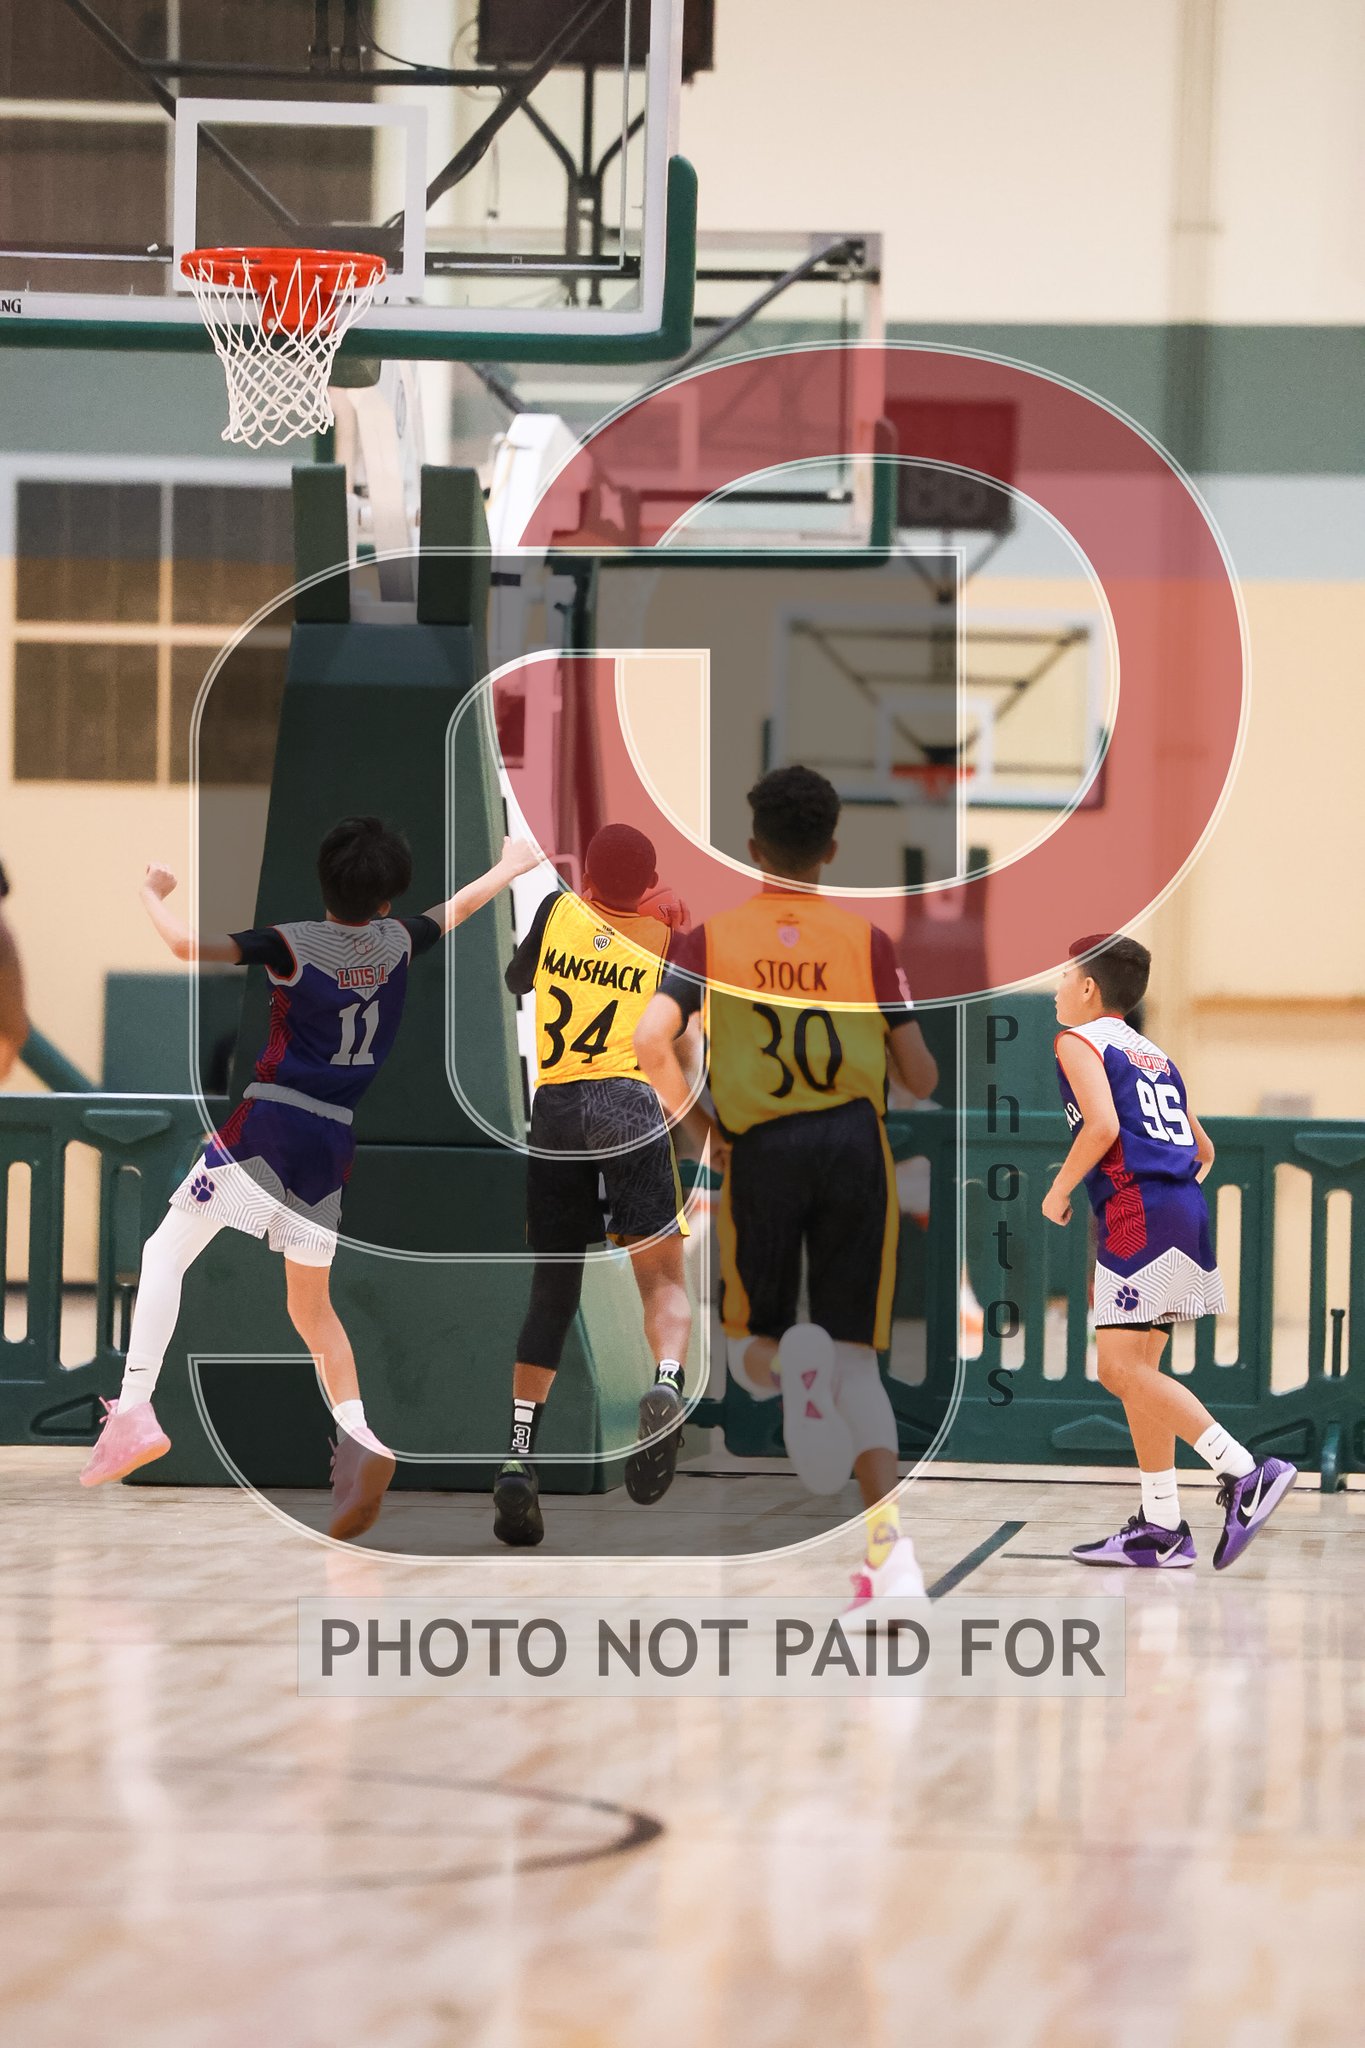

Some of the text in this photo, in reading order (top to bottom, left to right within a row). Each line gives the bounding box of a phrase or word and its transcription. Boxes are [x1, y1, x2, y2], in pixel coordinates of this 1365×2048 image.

[0, 298, 22, 314] NG
[338, 966, 376, 989] LUIS
[541, 946, 648, 994] MANSHACK
[753, 959, 828, 992] STOCK
[329, 1000, 380, 1066] 11
[541, 984, 620, 1069] 34
[752, 1003, 843, 1098] 30
[1135, 1077, 1195, 1147] 95
